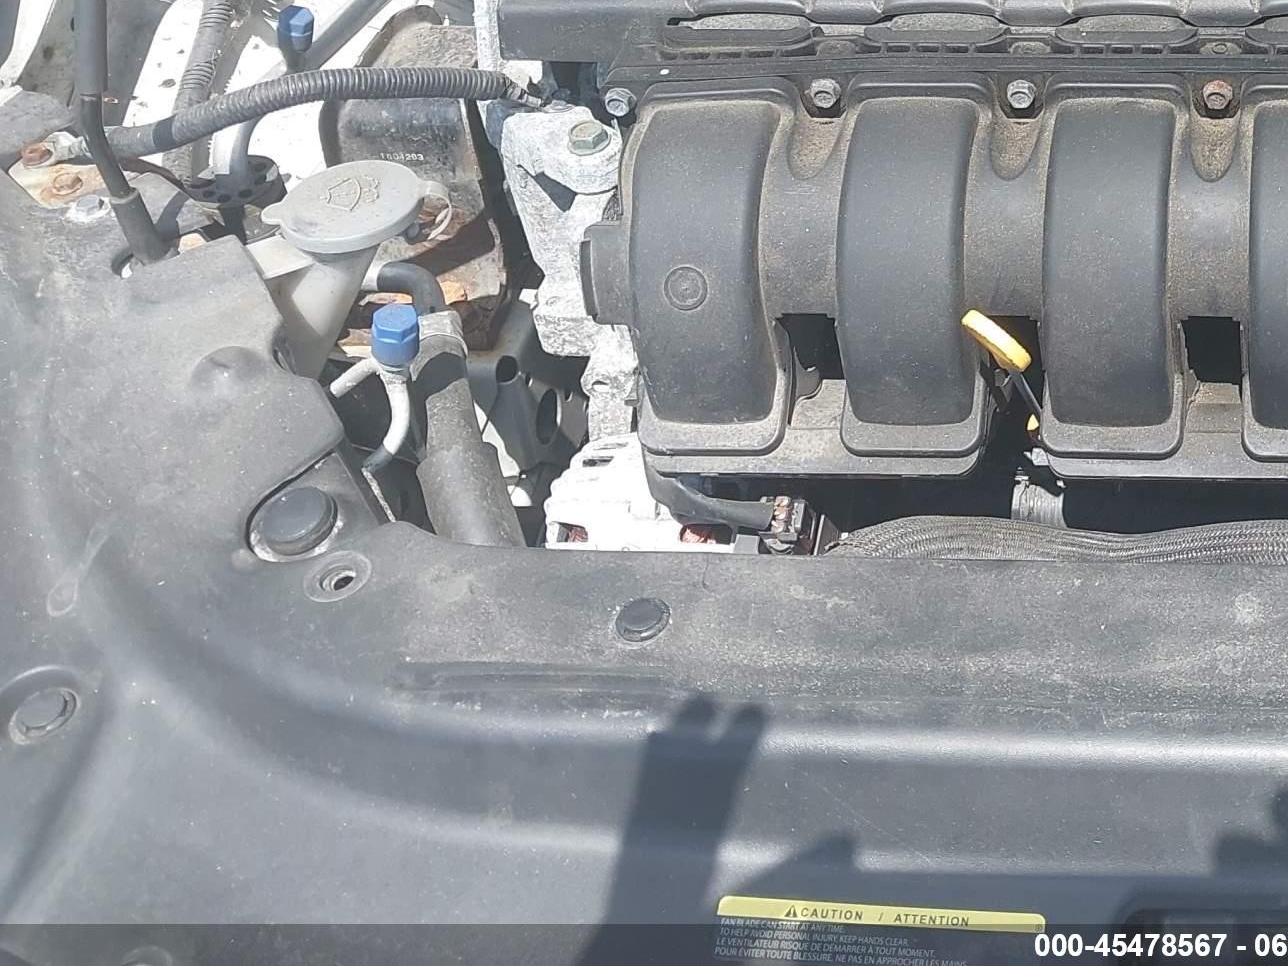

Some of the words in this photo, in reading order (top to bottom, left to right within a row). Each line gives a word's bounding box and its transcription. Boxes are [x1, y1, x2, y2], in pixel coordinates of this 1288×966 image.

[721, 918, 735, 926] FAN
[761, 920, 776, 929] CAN
[778, 921, 800, 930] START
[800, 907, 863, 921] CAUTION
[893, 912, 969, 927] ATTENTION
[727, 937, 780, 948] VENTILATEUR
[780, 941, 809, 951] RISQUE
[810, 943, 821, 951] DE
[874, 946, 896, 955] TOUT
[731, 928, 750, 936] HELP
[773, 930, 810, 941] PERSONAL
[839, 935, 857, 944] KEEP
[858, 937, 884, 946] HANDS
[714, 947, 737, 956] POUR
[739, 946, 766, 957] ÉVITER
[766, 949, 793, 960] TOUTE
[835, 954, 846, 963] NE
[847, 955, 863, 964] PAS
[864, 956, 875, 964] EN
[876, 956, 925, 966] APPROCHER
[926, 958, 940, 966] LES
